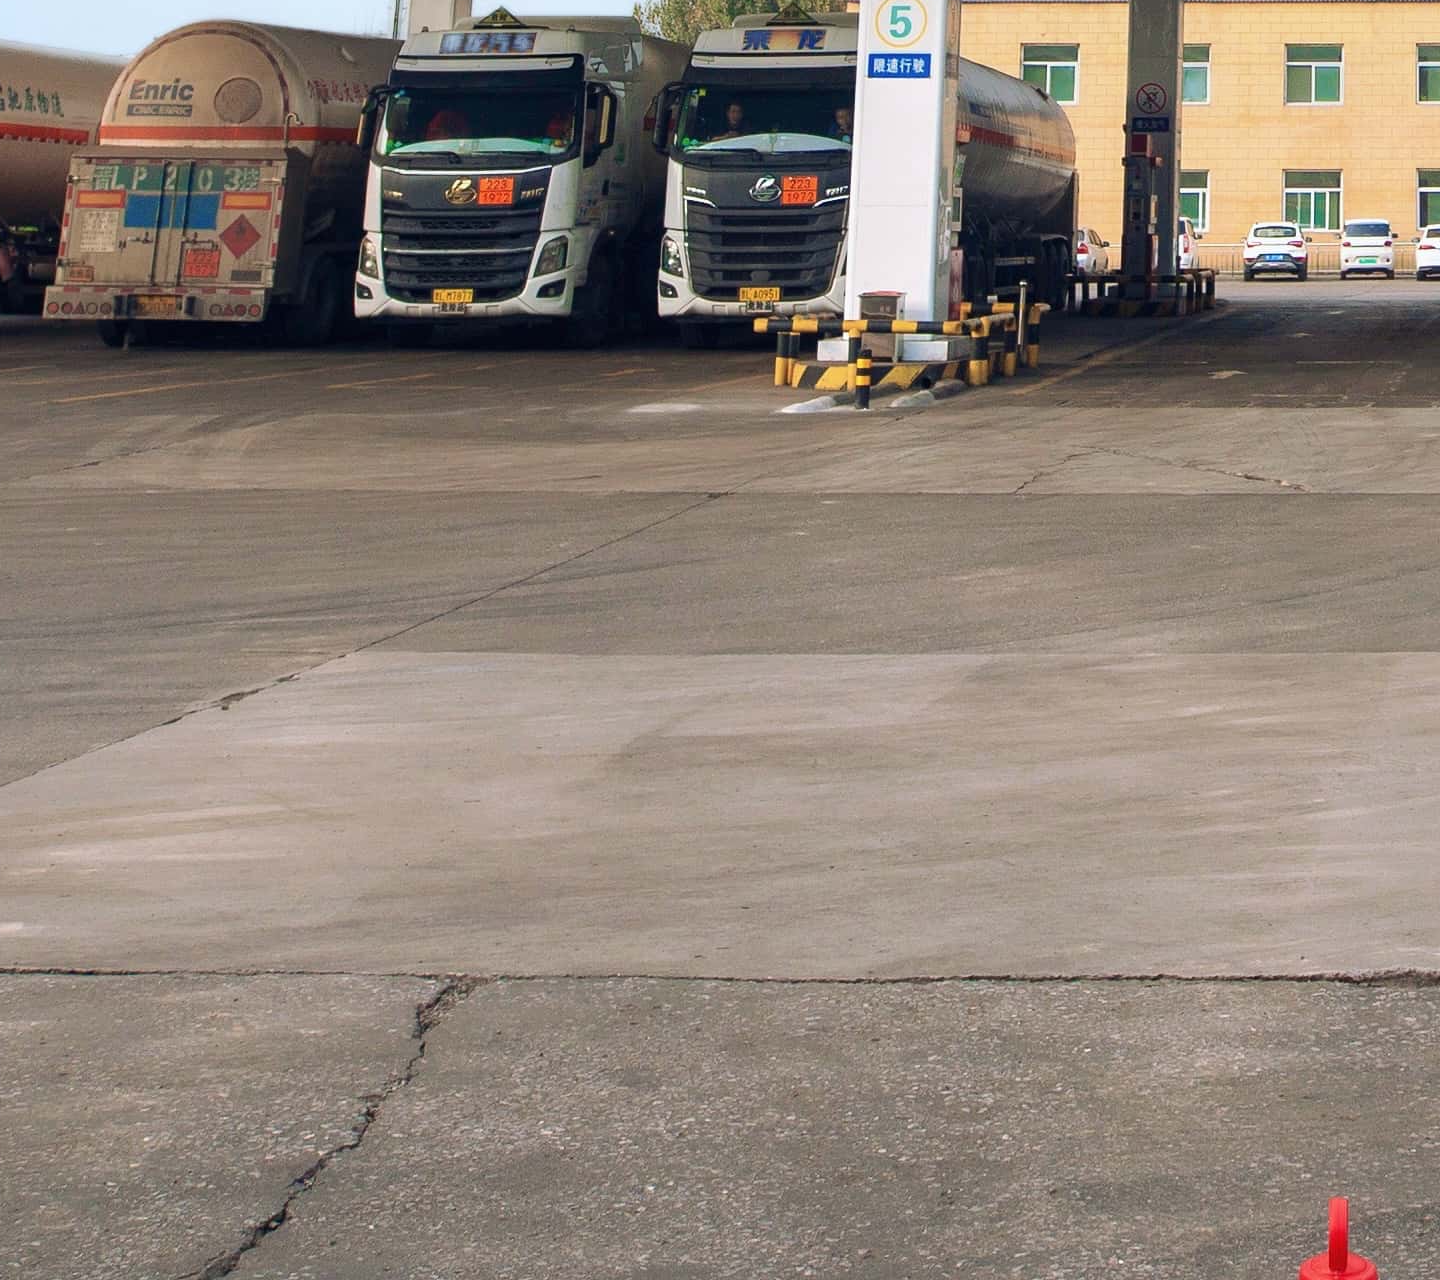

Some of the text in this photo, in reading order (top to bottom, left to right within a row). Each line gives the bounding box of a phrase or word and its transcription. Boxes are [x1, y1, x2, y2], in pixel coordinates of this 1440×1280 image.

[889, 5, 912, 39] 5
[873, 58, 925, 73] 限速行驶
[129, 78, 194, 101] Enric
[487, 178, 508, 189] 223
[789, 178, 811, 189] 223
[482, 192, 511, 203] 1972
[786, 192, 815, 204] 1972
